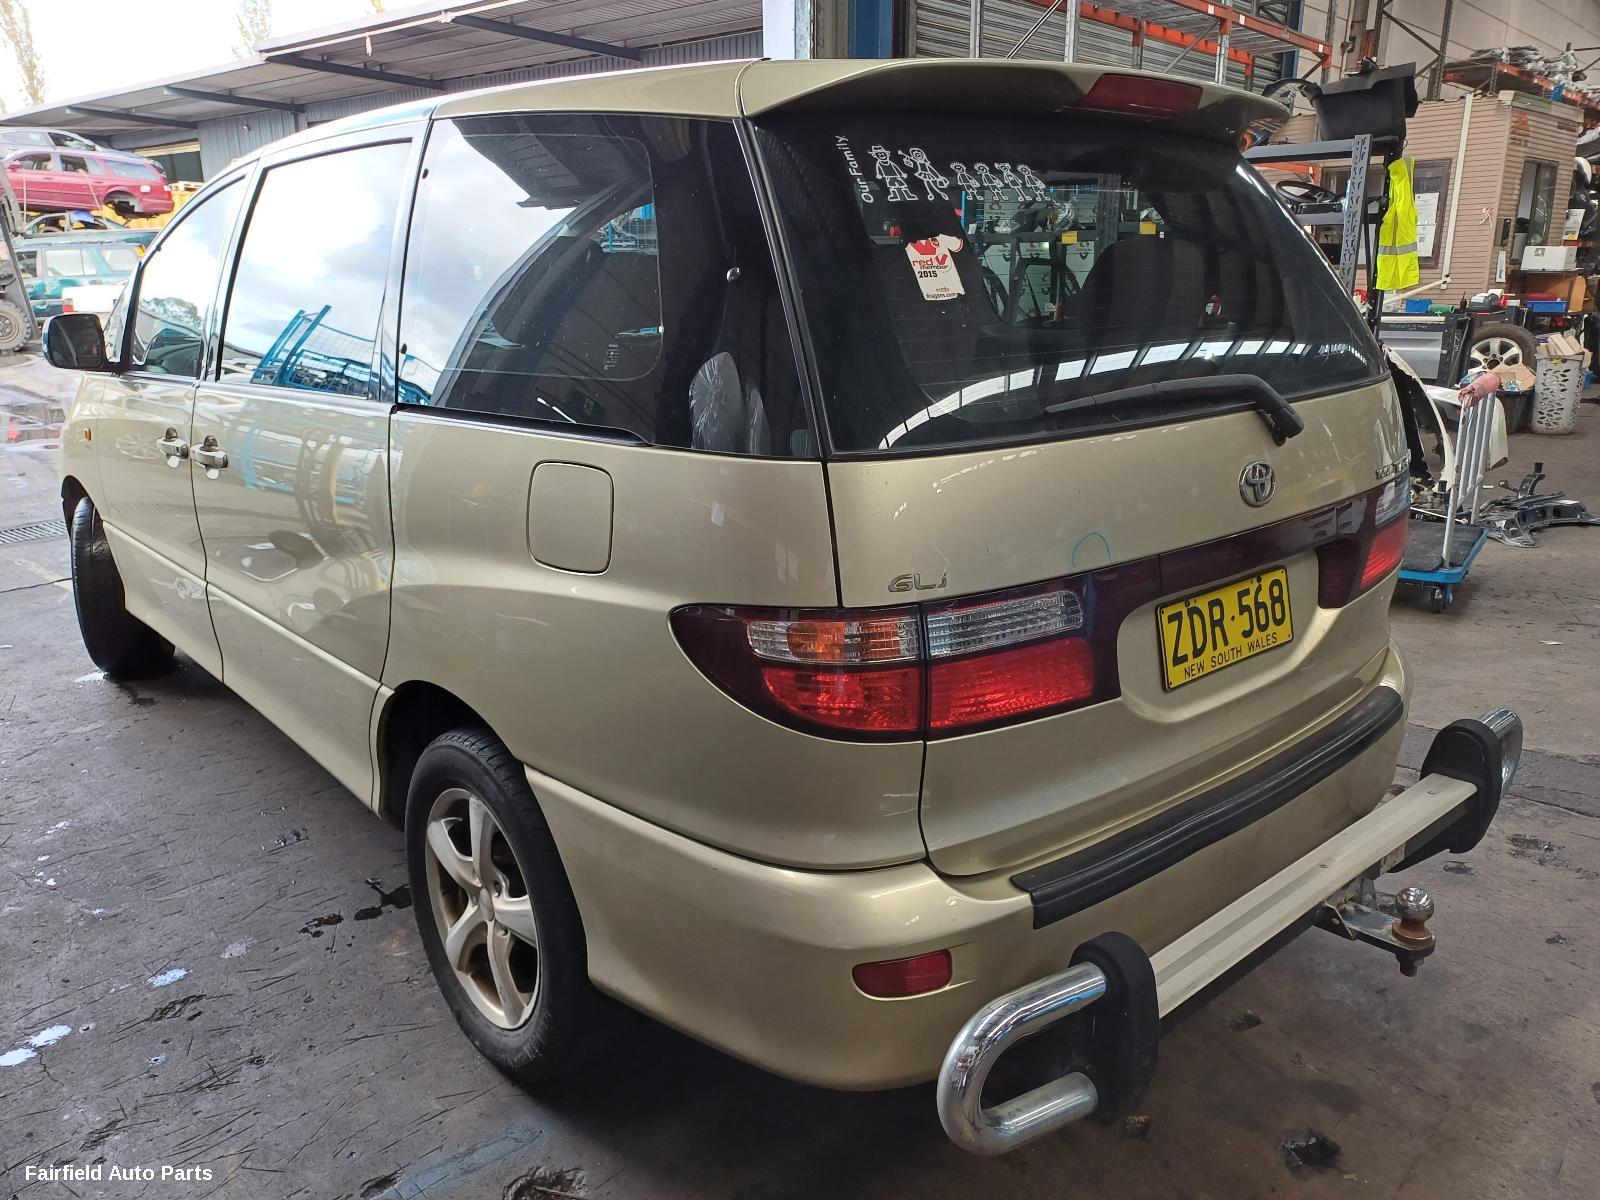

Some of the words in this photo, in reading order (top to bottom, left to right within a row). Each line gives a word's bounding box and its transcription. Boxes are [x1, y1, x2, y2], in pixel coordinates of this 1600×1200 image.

[835, 134, 863, 176] Family
[857, 178, 874, 203] Our
[912, 258, 934, 266] red
[918, 270, 938, 278] 2015
[1184, 661, 1205, 680] NEW
[1210, 645, 1242, 668] SOUTH
[1247, 632, 1278, 653] WALES
